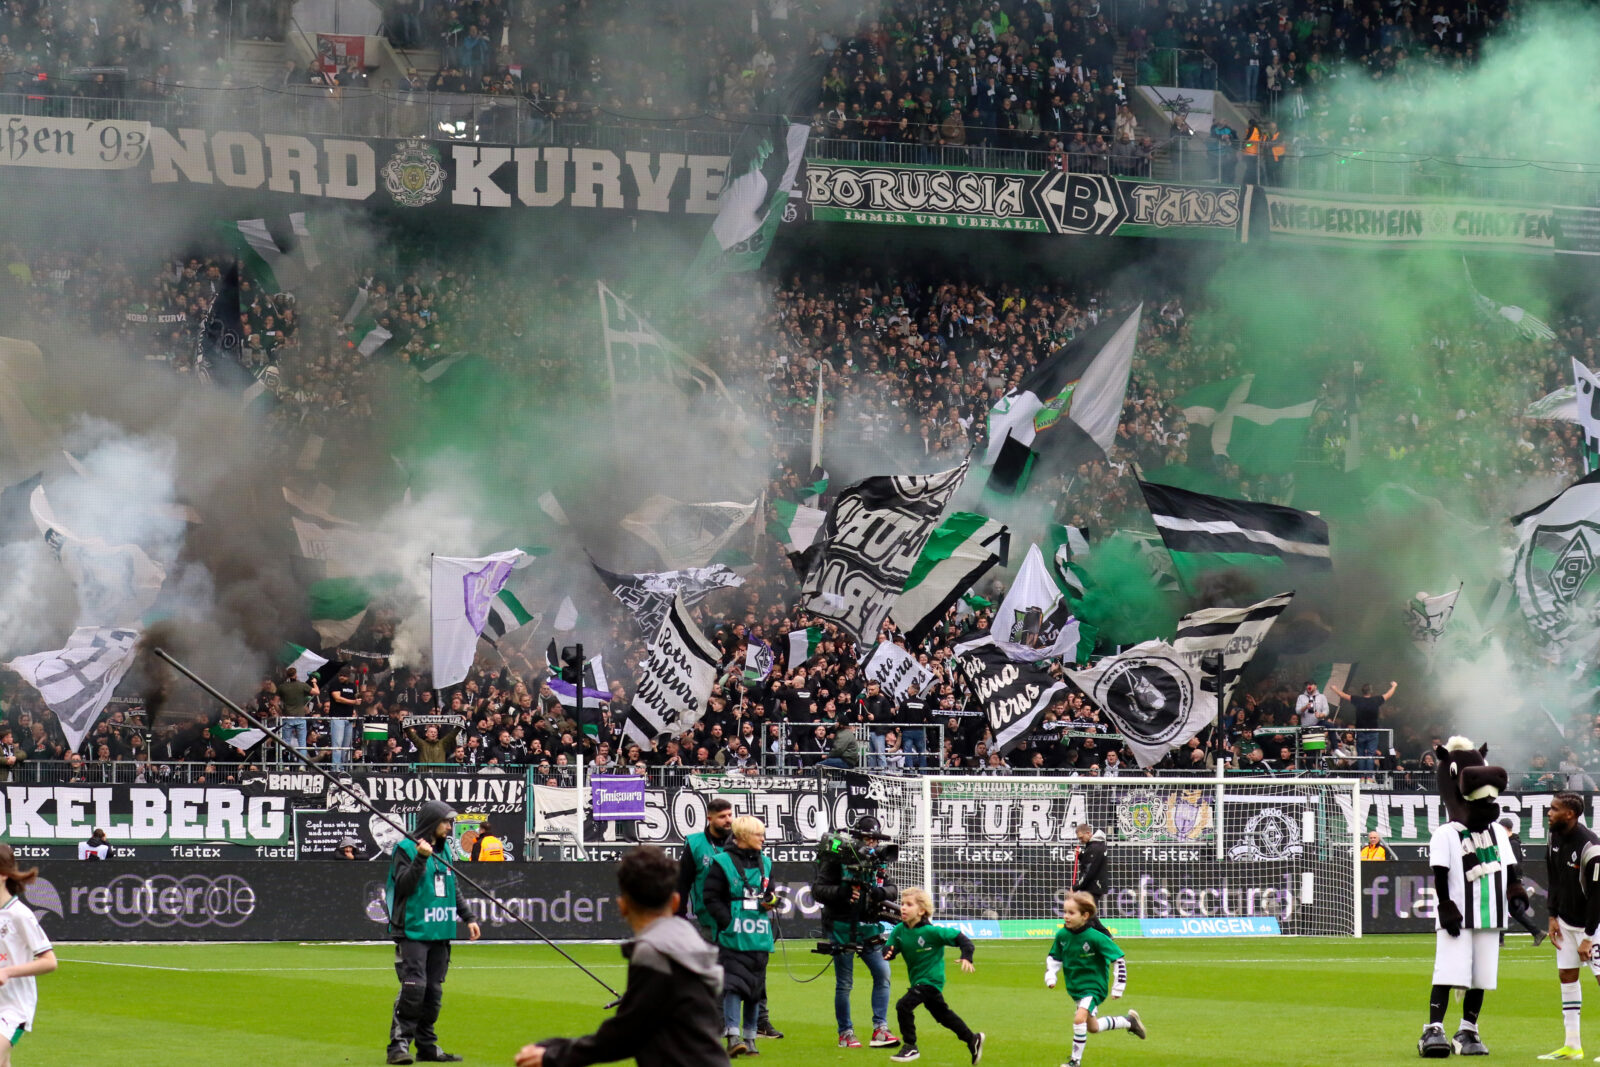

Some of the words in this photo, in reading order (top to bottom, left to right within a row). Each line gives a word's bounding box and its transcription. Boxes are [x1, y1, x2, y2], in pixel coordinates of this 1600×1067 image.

[150, 127, 376, 200] NORD
[452, 145, 731, 214] KURVE
[806, 168, 1024, 218] BORUSSIA
[1134, 186, 1239, 228] FANS
[845, 211, 906, 223] IMMER
[916, 215, 948, 226] UND
[956, 214, 1039, 230] ÜBERALL!
[1270, 201, 1423, 237] NIEDERRHEIN
[269, 774, 325, 790] BANDA
[303, 786, 322, 794] SUD
[366, 777, 526, 804] FRONTLINE
[0, 786, 286, 839] KELBERG
[390, 802, 422, 813] Ackerb
[465, 803, 486, 813] seit
[490, 803, 523, 813] 2006
[1260, 807, 1282, 816] 1900
[13, 847, 50, 858] atex
[171, 845, 221, 859] flatex
[955, 846, 1014, 862] flatex
[1142, 846, 1199, 861] flatex
[425, 907, 457, 922] HOST
[1179, 918, 1255, 934] JONGEN
